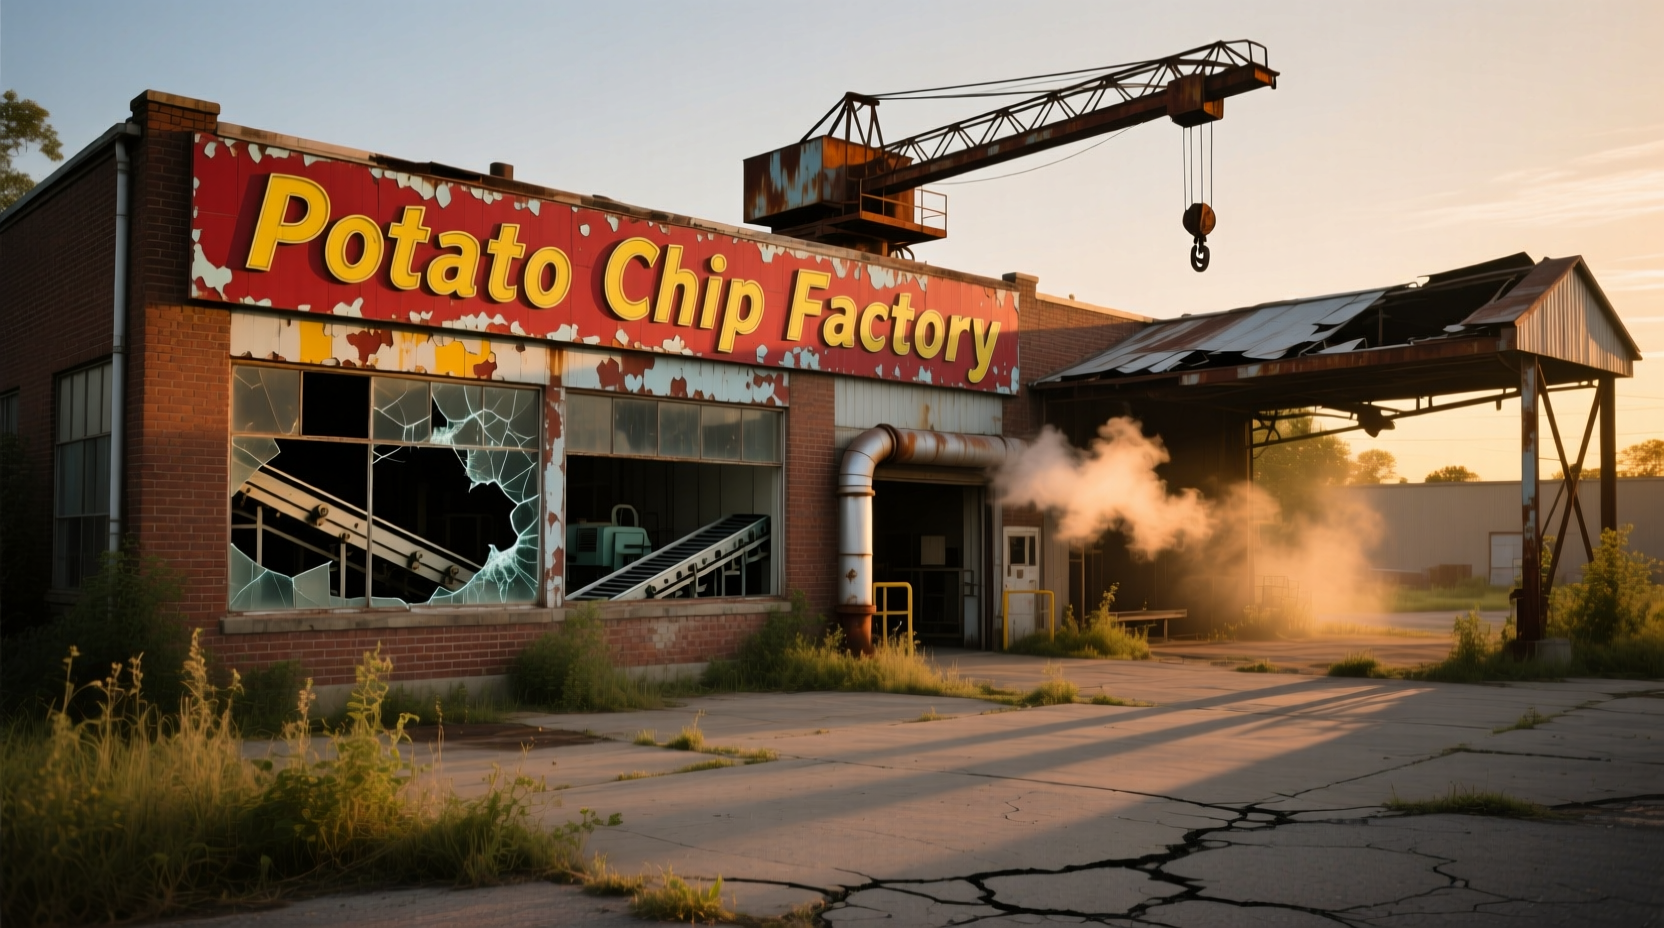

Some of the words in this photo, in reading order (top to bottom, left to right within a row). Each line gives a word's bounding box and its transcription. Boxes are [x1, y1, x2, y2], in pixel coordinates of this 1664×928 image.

[245, 172, 572, 309] Potato
[604, 237, 765, 353] Chip
[786, 269, 1001, 383] Factory
